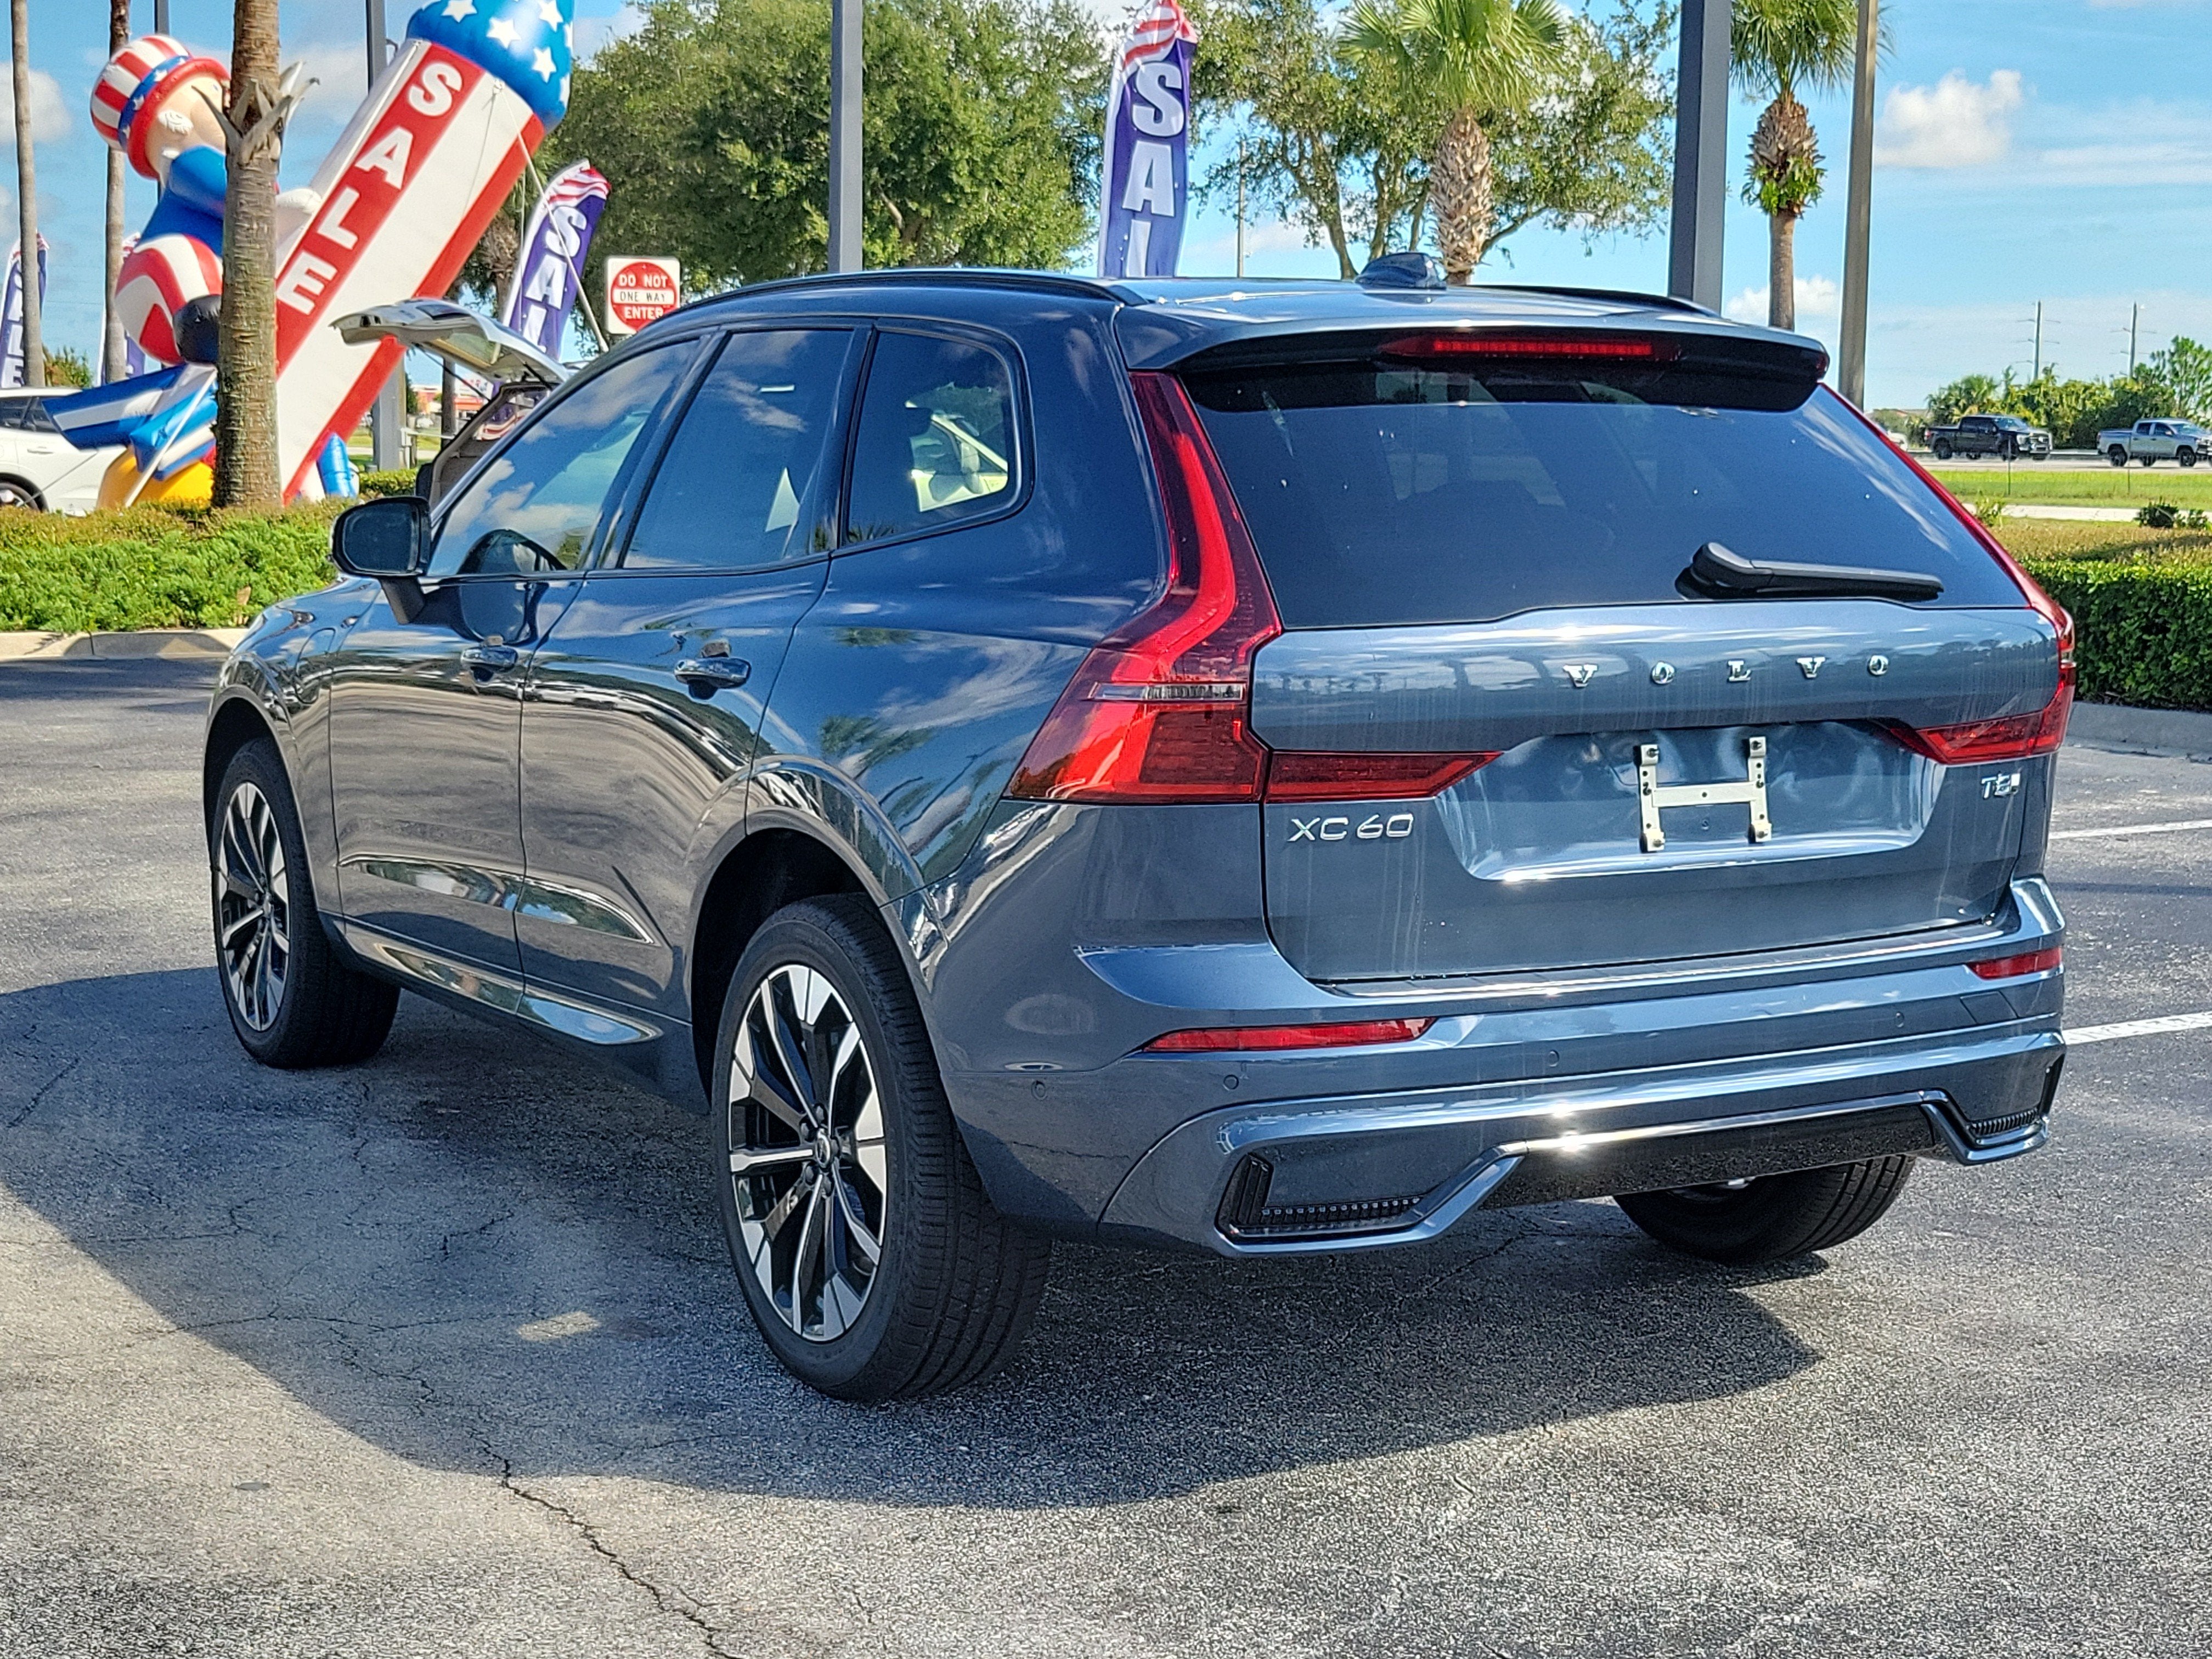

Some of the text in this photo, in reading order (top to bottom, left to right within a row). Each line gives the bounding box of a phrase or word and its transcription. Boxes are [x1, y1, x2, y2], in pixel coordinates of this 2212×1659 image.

[276, 63, 462, 315] SALE
[619, 274, 668, 287] DO NOT
[620, 291, 666, 302] ONE WAY
[624, 306, 664, 319] ENTER
[1562, 654, 1890, 688] VOLVO
